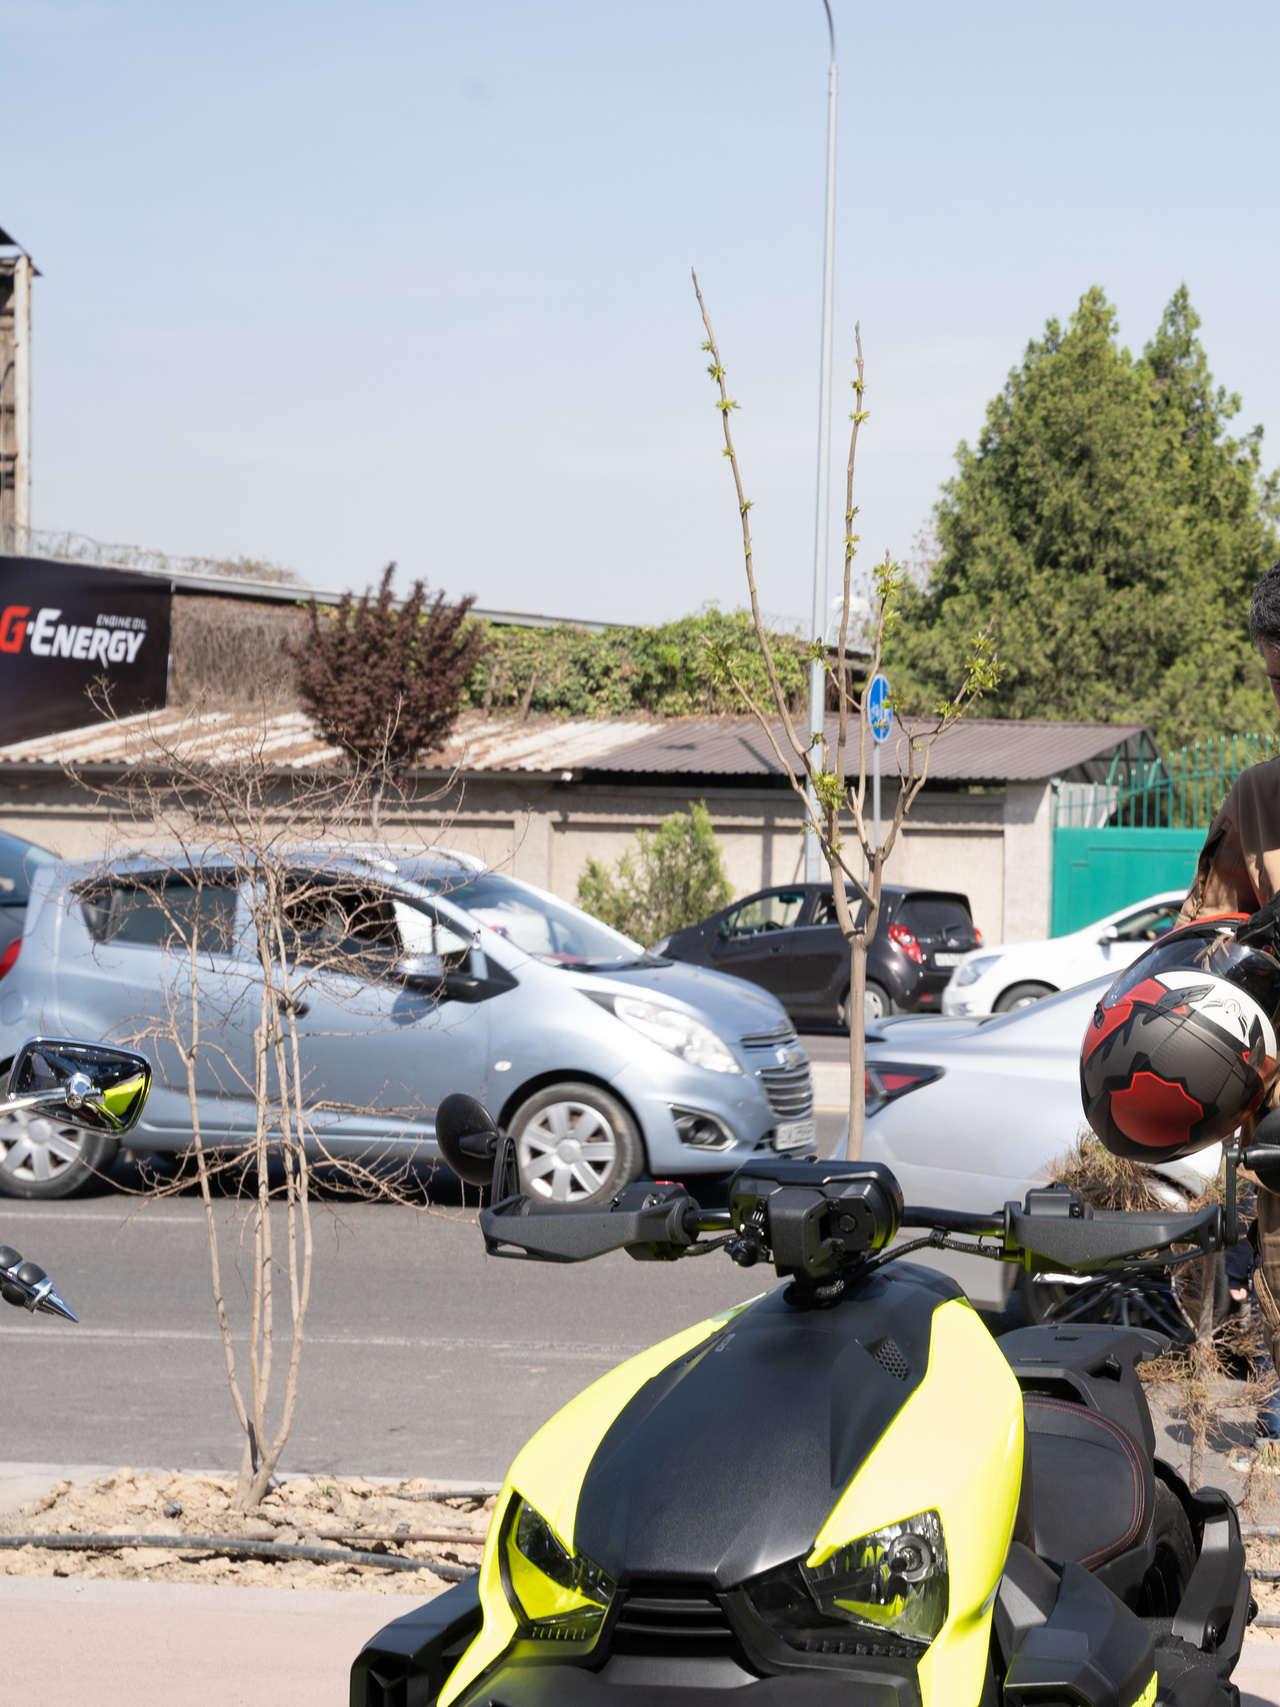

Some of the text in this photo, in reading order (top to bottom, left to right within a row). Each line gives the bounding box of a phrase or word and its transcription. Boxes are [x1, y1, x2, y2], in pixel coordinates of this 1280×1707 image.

[0, 605, 146, 669] G-ENERGY
[96, 613, 148, 631] ENGINE OIL
